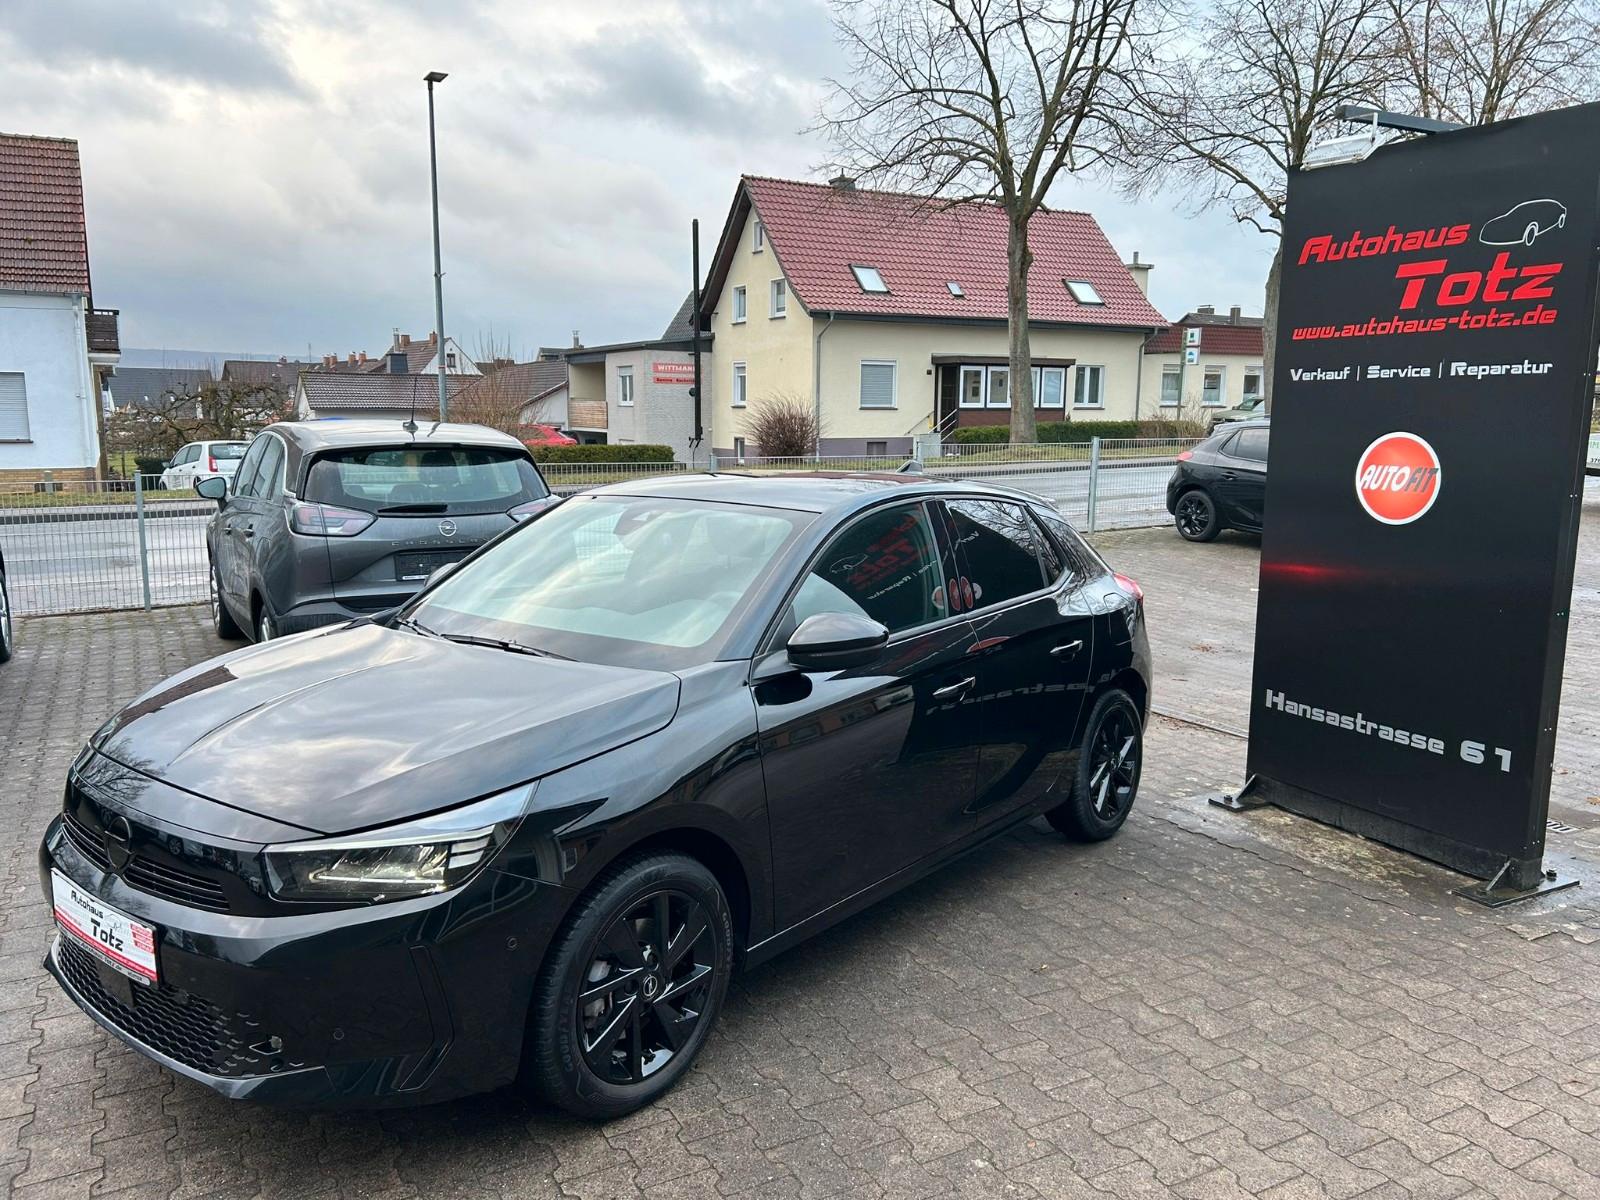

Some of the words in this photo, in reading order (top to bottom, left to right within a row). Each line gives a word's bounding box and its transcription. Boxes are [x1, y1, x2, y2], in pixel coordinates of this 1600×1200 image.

[1298, 224, 1471, 264] Autohaus
[1395, 252, 1563, 310] Totz
[1292, 304, 1557, 340] www.autohaus-totz.de
[1290, 366, 1350, 382] Verkauf
[1367, 365, 1430, 379] Service
[1450, 360, 1553, 380] Reparatur
[1360, 464, 1439, 493] AUTOFIT
[1265, 688, 1445, 755] Hansastrasse
[71, 890, 103, 918] Autohaus
[91, 918, 124, 952] Totz
